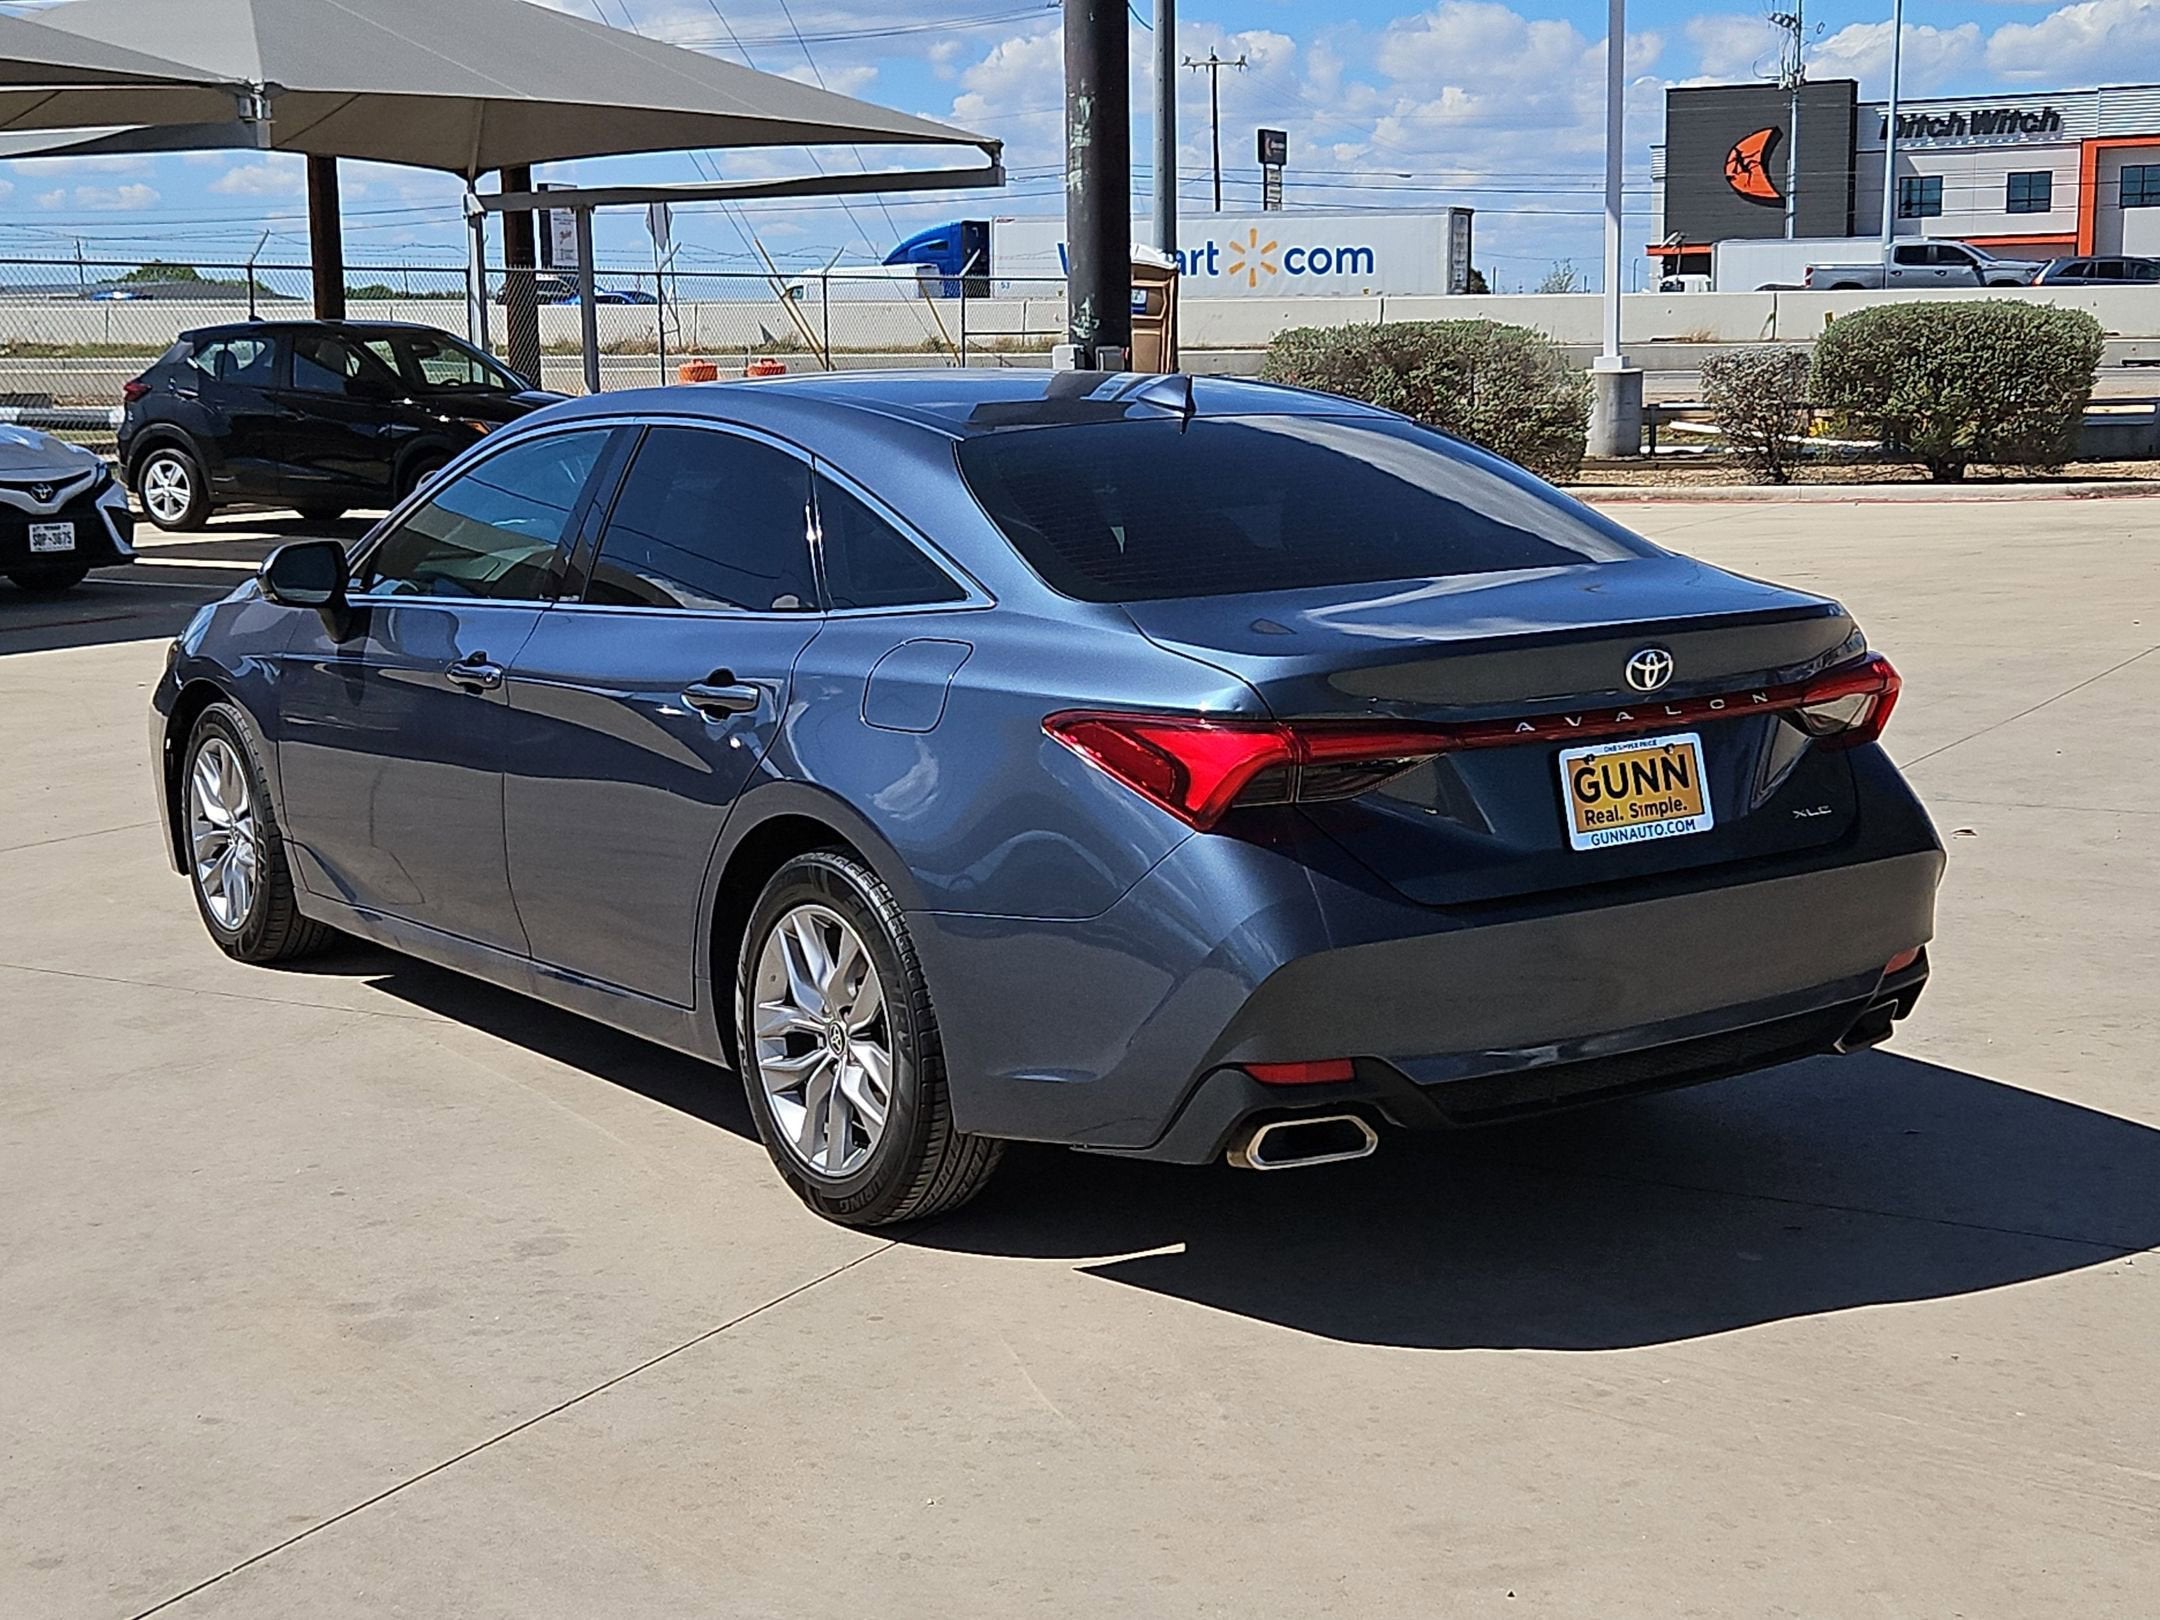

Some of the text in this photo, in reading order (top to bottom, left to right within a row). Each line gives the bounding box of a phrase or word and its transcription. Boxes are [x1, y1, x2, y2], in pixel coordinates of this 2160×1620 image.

[1969, 106, 2062, 135] Witch
[1515, 692, 1768, 733] AVALON
[1573, 754, 1690, 803] GUNN
[1584, 796, 1688, 826] Real. Simple.
[1591, 819, 1696, 846] GUNNAUTO.COM
